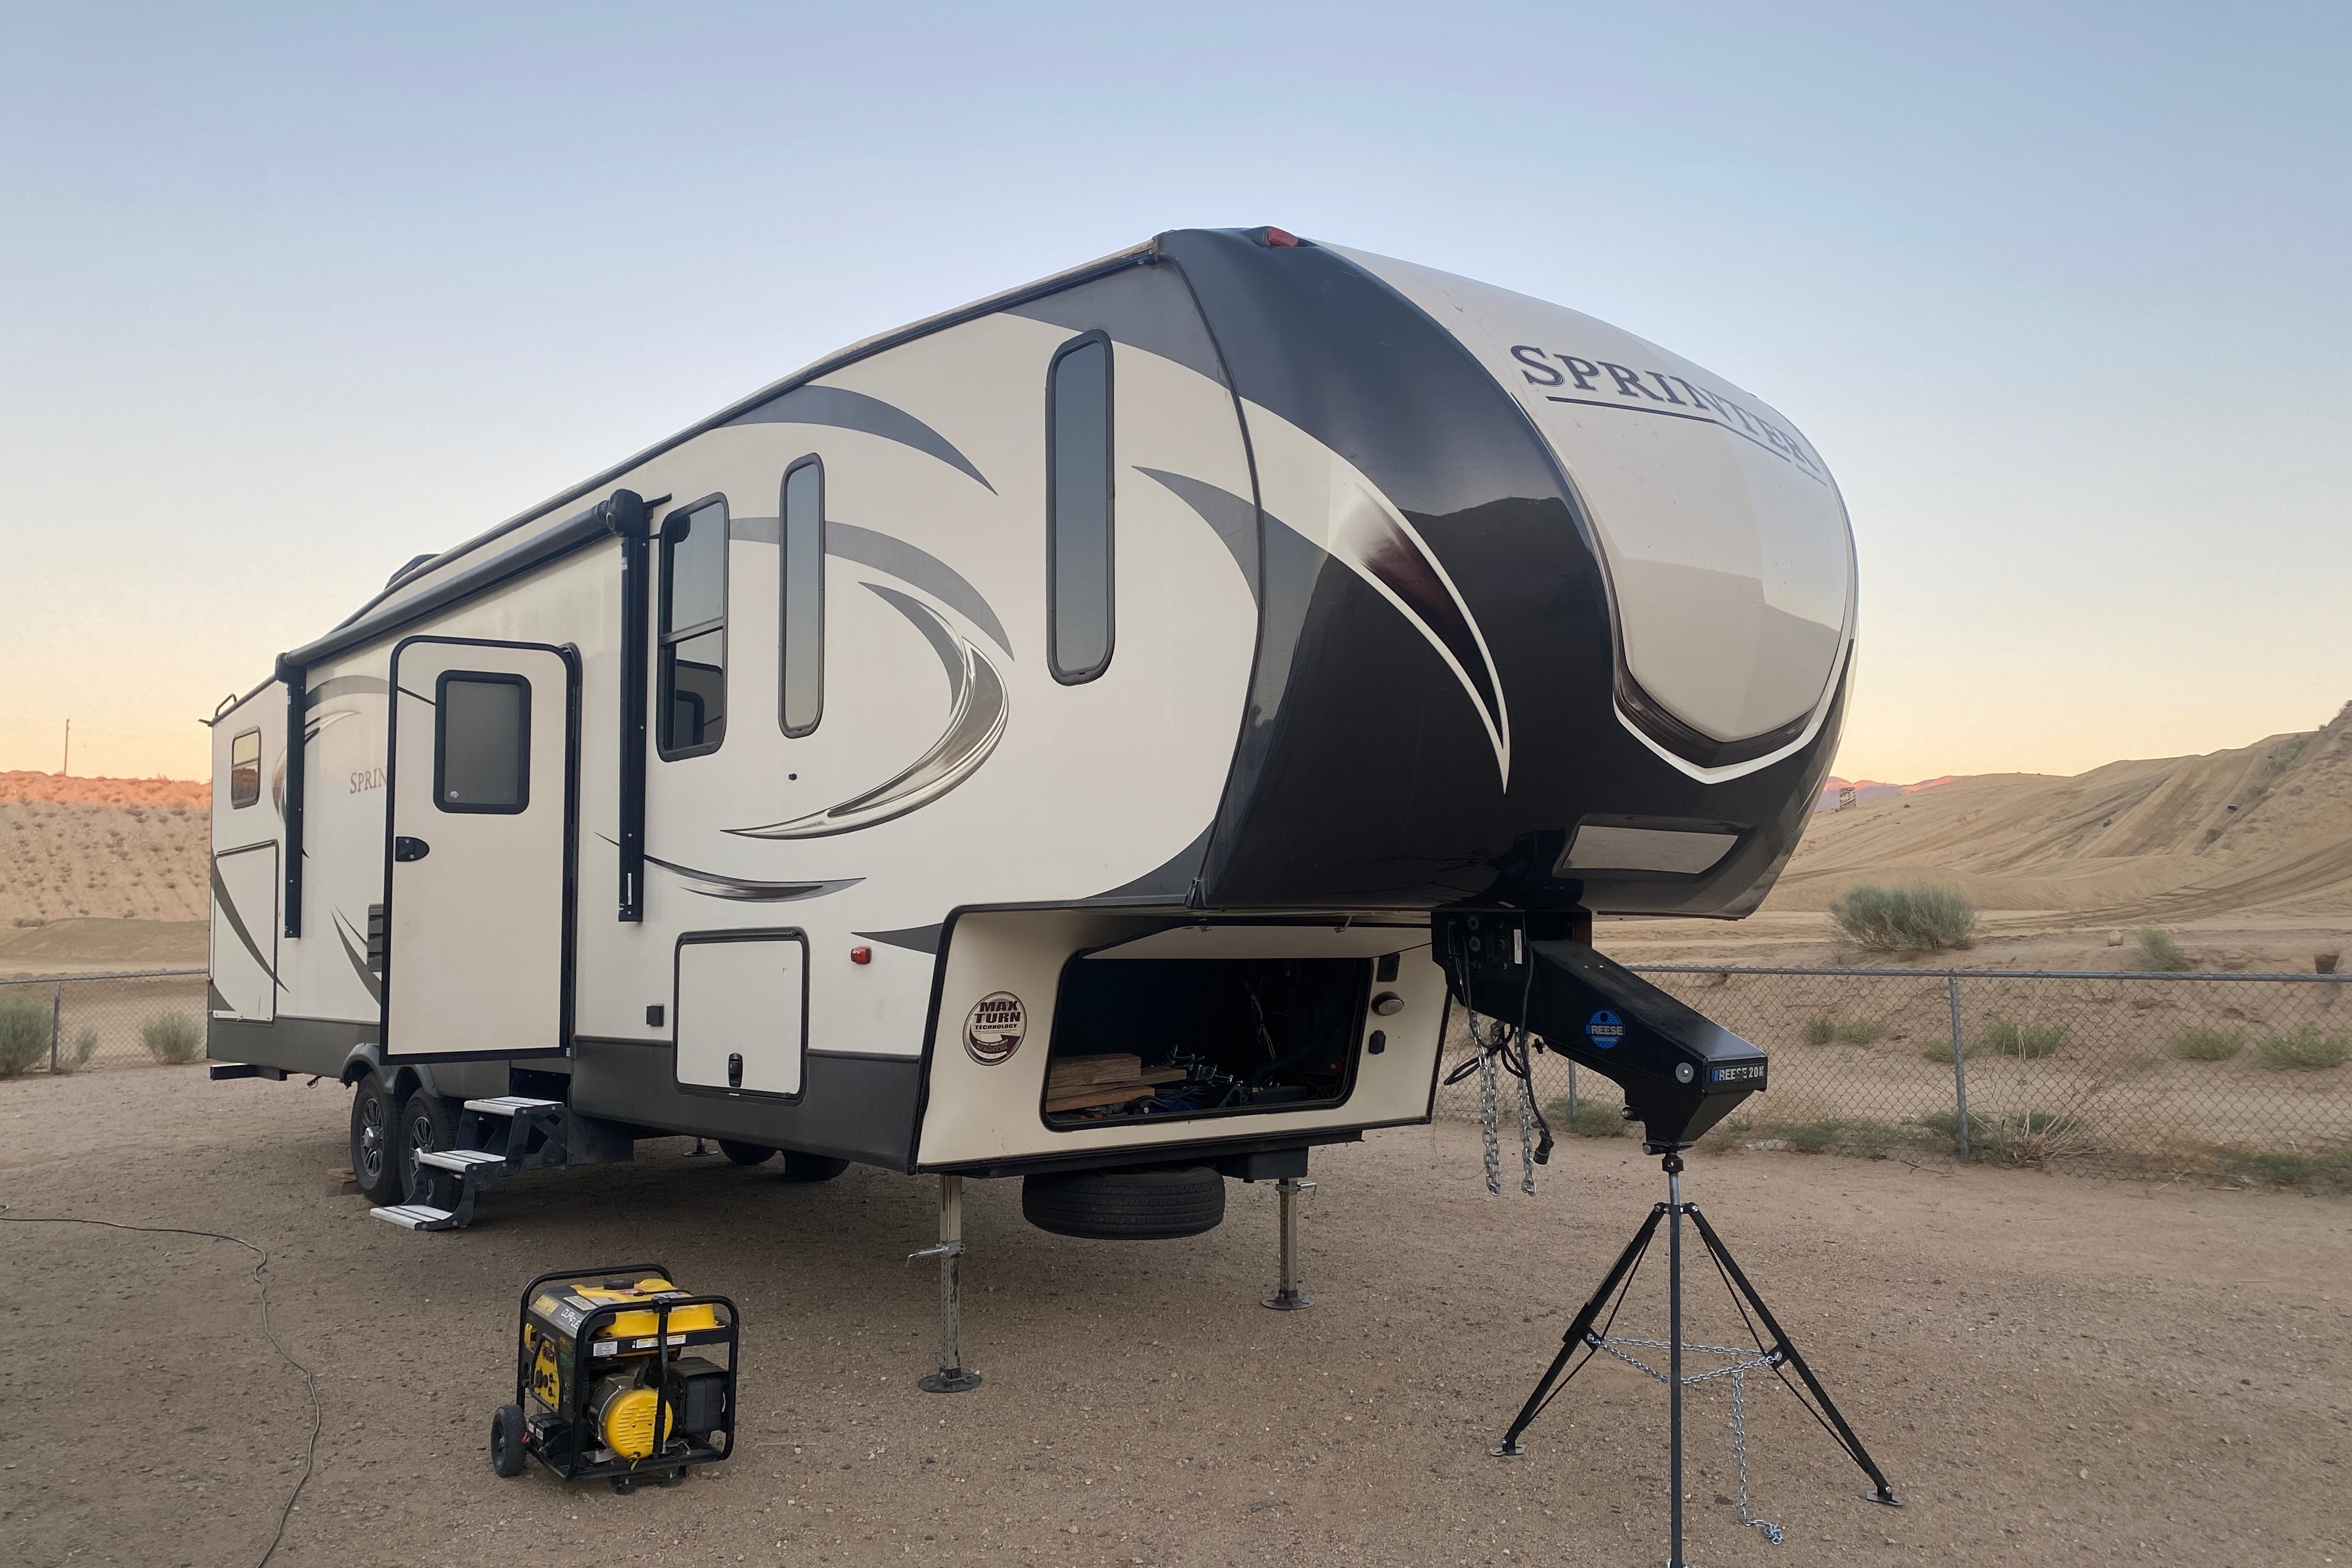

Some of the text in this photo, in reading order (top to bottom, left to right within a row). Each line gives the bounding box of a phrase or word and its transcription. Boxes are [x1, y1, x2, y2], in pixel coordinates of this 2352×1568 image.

[1510, 345, 1821, 473] SPRINTER
[979, 1000, 1018, 1012] MAX
[974, 1012, 1021, 1024] TURN
[1591, 1025, 1623, 1035] REESE
[1748, 1065, 1765, 1079] 20K
